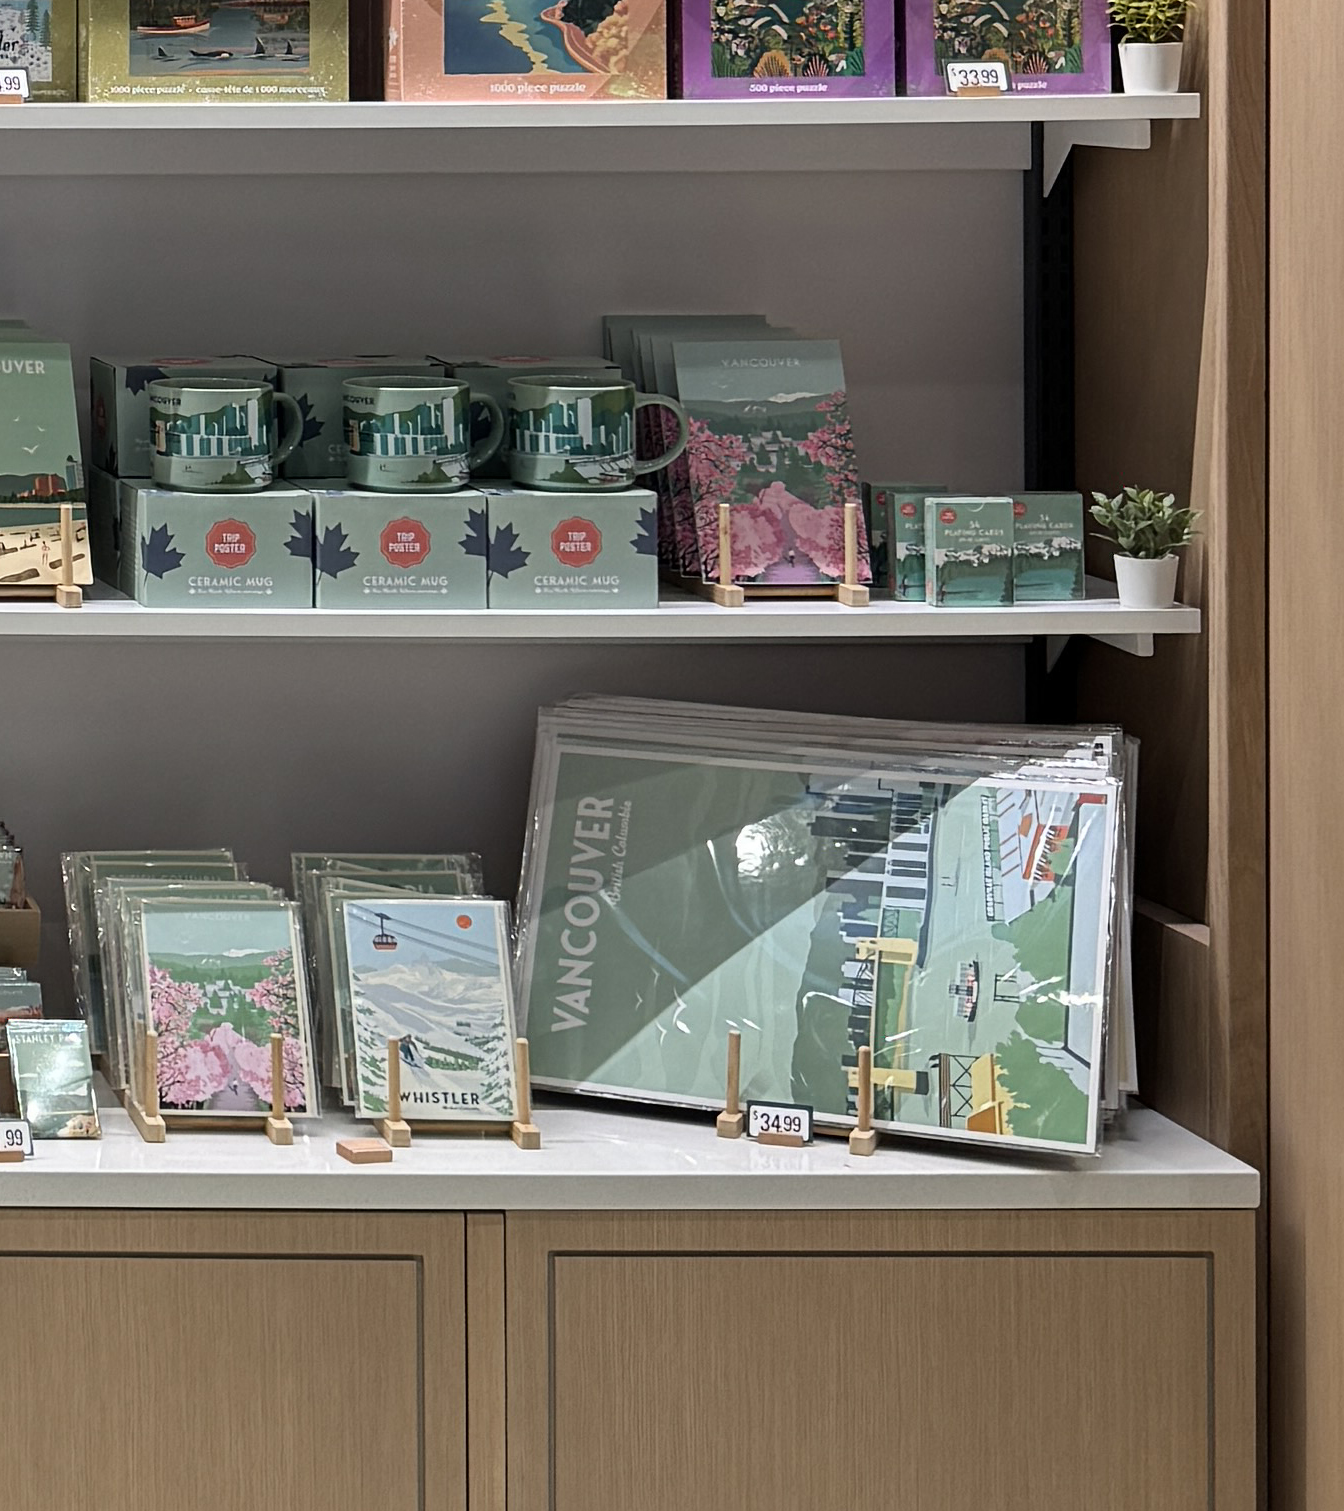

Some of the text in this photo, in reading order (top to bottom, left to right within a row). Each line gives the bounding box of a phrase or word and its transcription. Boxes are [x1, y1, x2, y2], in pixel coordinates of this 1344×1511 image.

[490, 81, 586, 95] 1000 piece puzzle
[748, 83, 828, 94] 500 piece puzzle
[721, 357, 801, 369] VANCOUVER
[222, 532, 240, 543] TRIP
[396, 531, 415, 542] TRIP
[567, 531, 587, 542] TRIP
[214, 543, 246, 554] POSTER
[388, 542, 421, 553] POSTER
[559, 542, 592, 553] POSTER
[188, 576, 274, 587] CERAMIC MUG
[362, 575, 449, 587] CERAMIC MUG
[533, 575, 620, 586] CERAMIC MUG
[611, 799, 633, 857] Columbia
[604, 858, 627, 906] British
[550, 795, 615, 1033] VANCOUVER
[400, 1092, 480, 1105] WHISTLER
